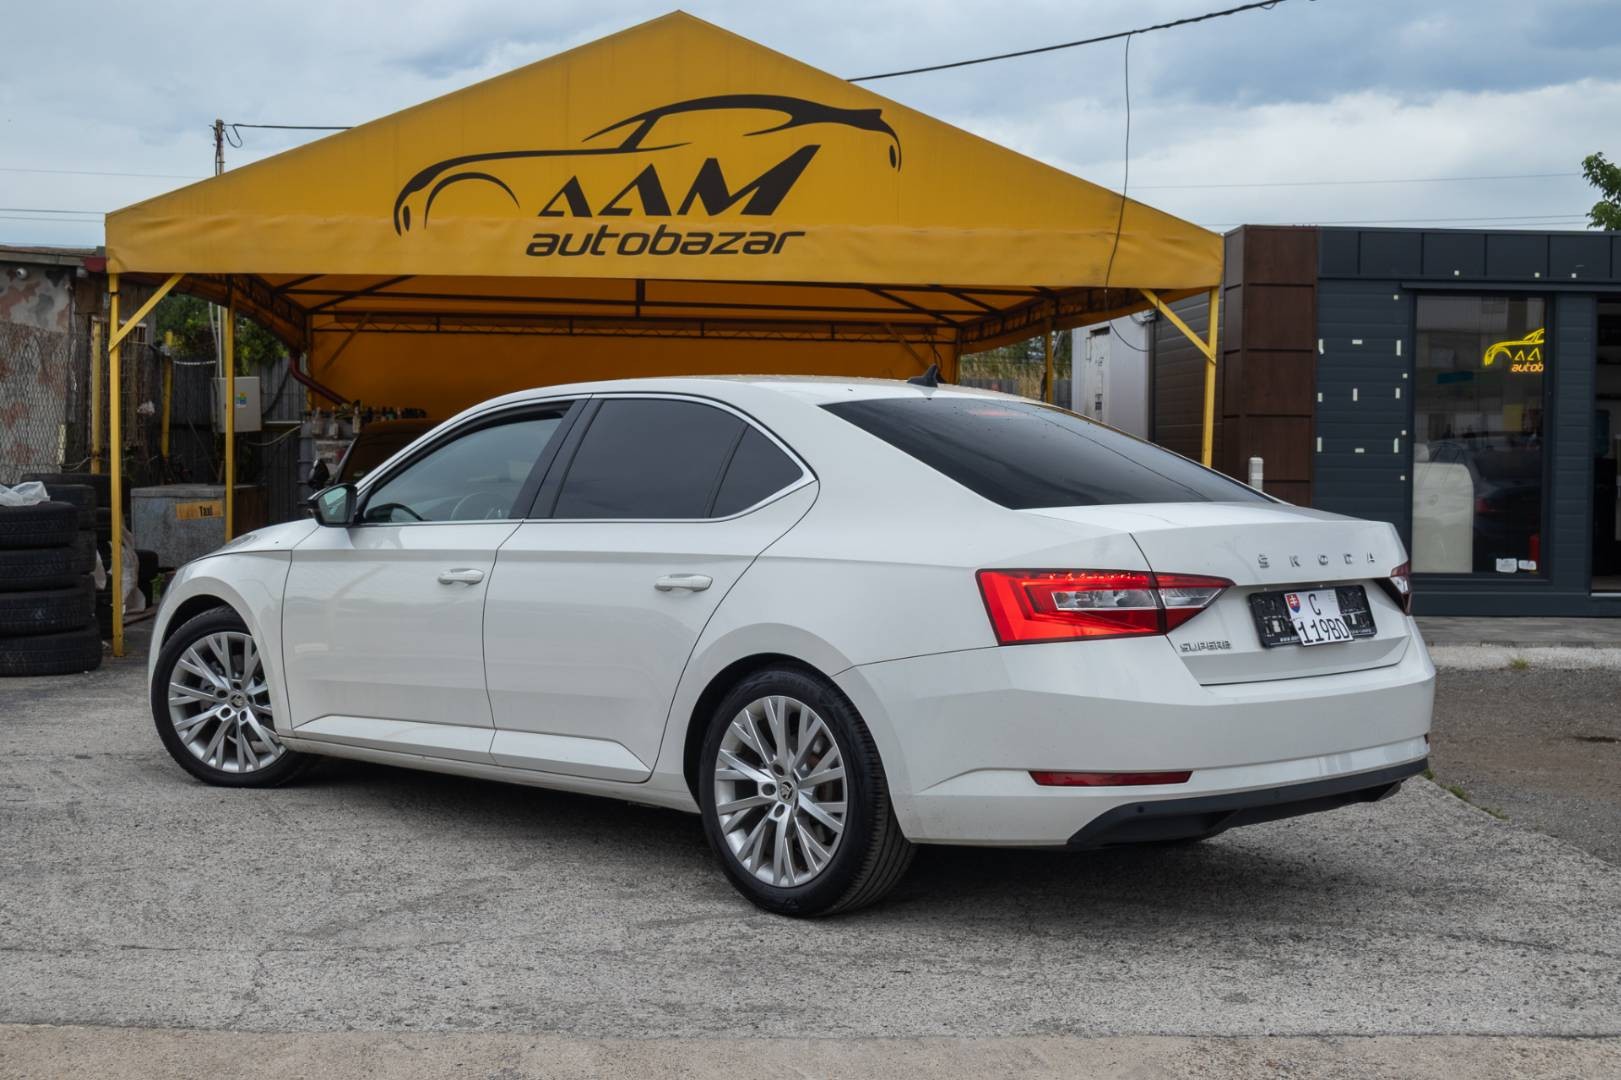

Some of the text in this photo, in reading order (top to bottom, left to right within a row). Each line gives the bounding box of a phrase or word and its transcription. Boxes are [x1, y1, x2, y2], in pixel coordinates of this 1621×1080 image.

[537, 144, 821, 218] AAM
[525, 224, 805, 257] autobazar
[1308, 593, 1321, 616] C
[1298, 617, 1350, 644] 119BD
[1180, 640, 1232, 652] SUPERB
